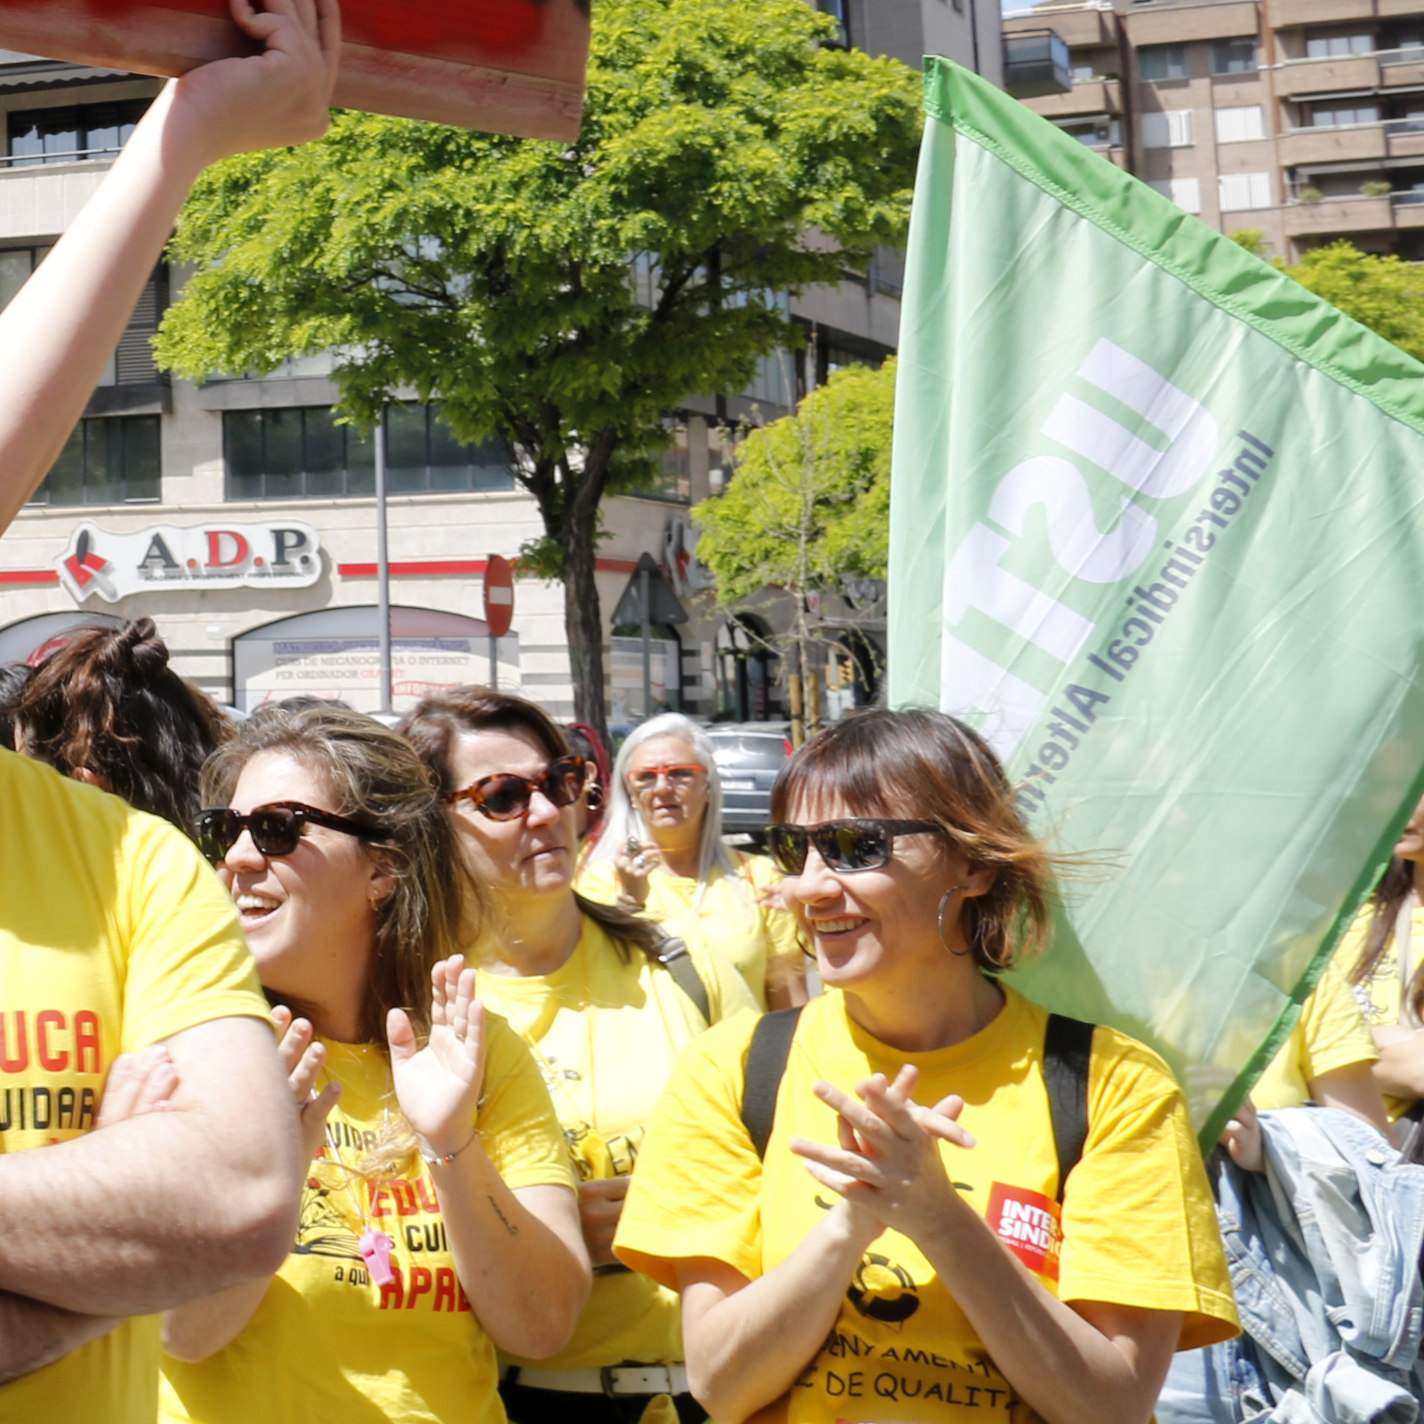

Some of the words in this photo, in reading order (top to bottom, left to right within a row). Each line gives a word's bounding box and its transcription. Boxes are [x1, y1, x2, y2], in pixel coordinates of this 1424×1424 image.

[137, 529, 310, 570] A.D.P.
[406, 1223, 448, 1253] CUI
[826, 1371, 864, 1397] DE
